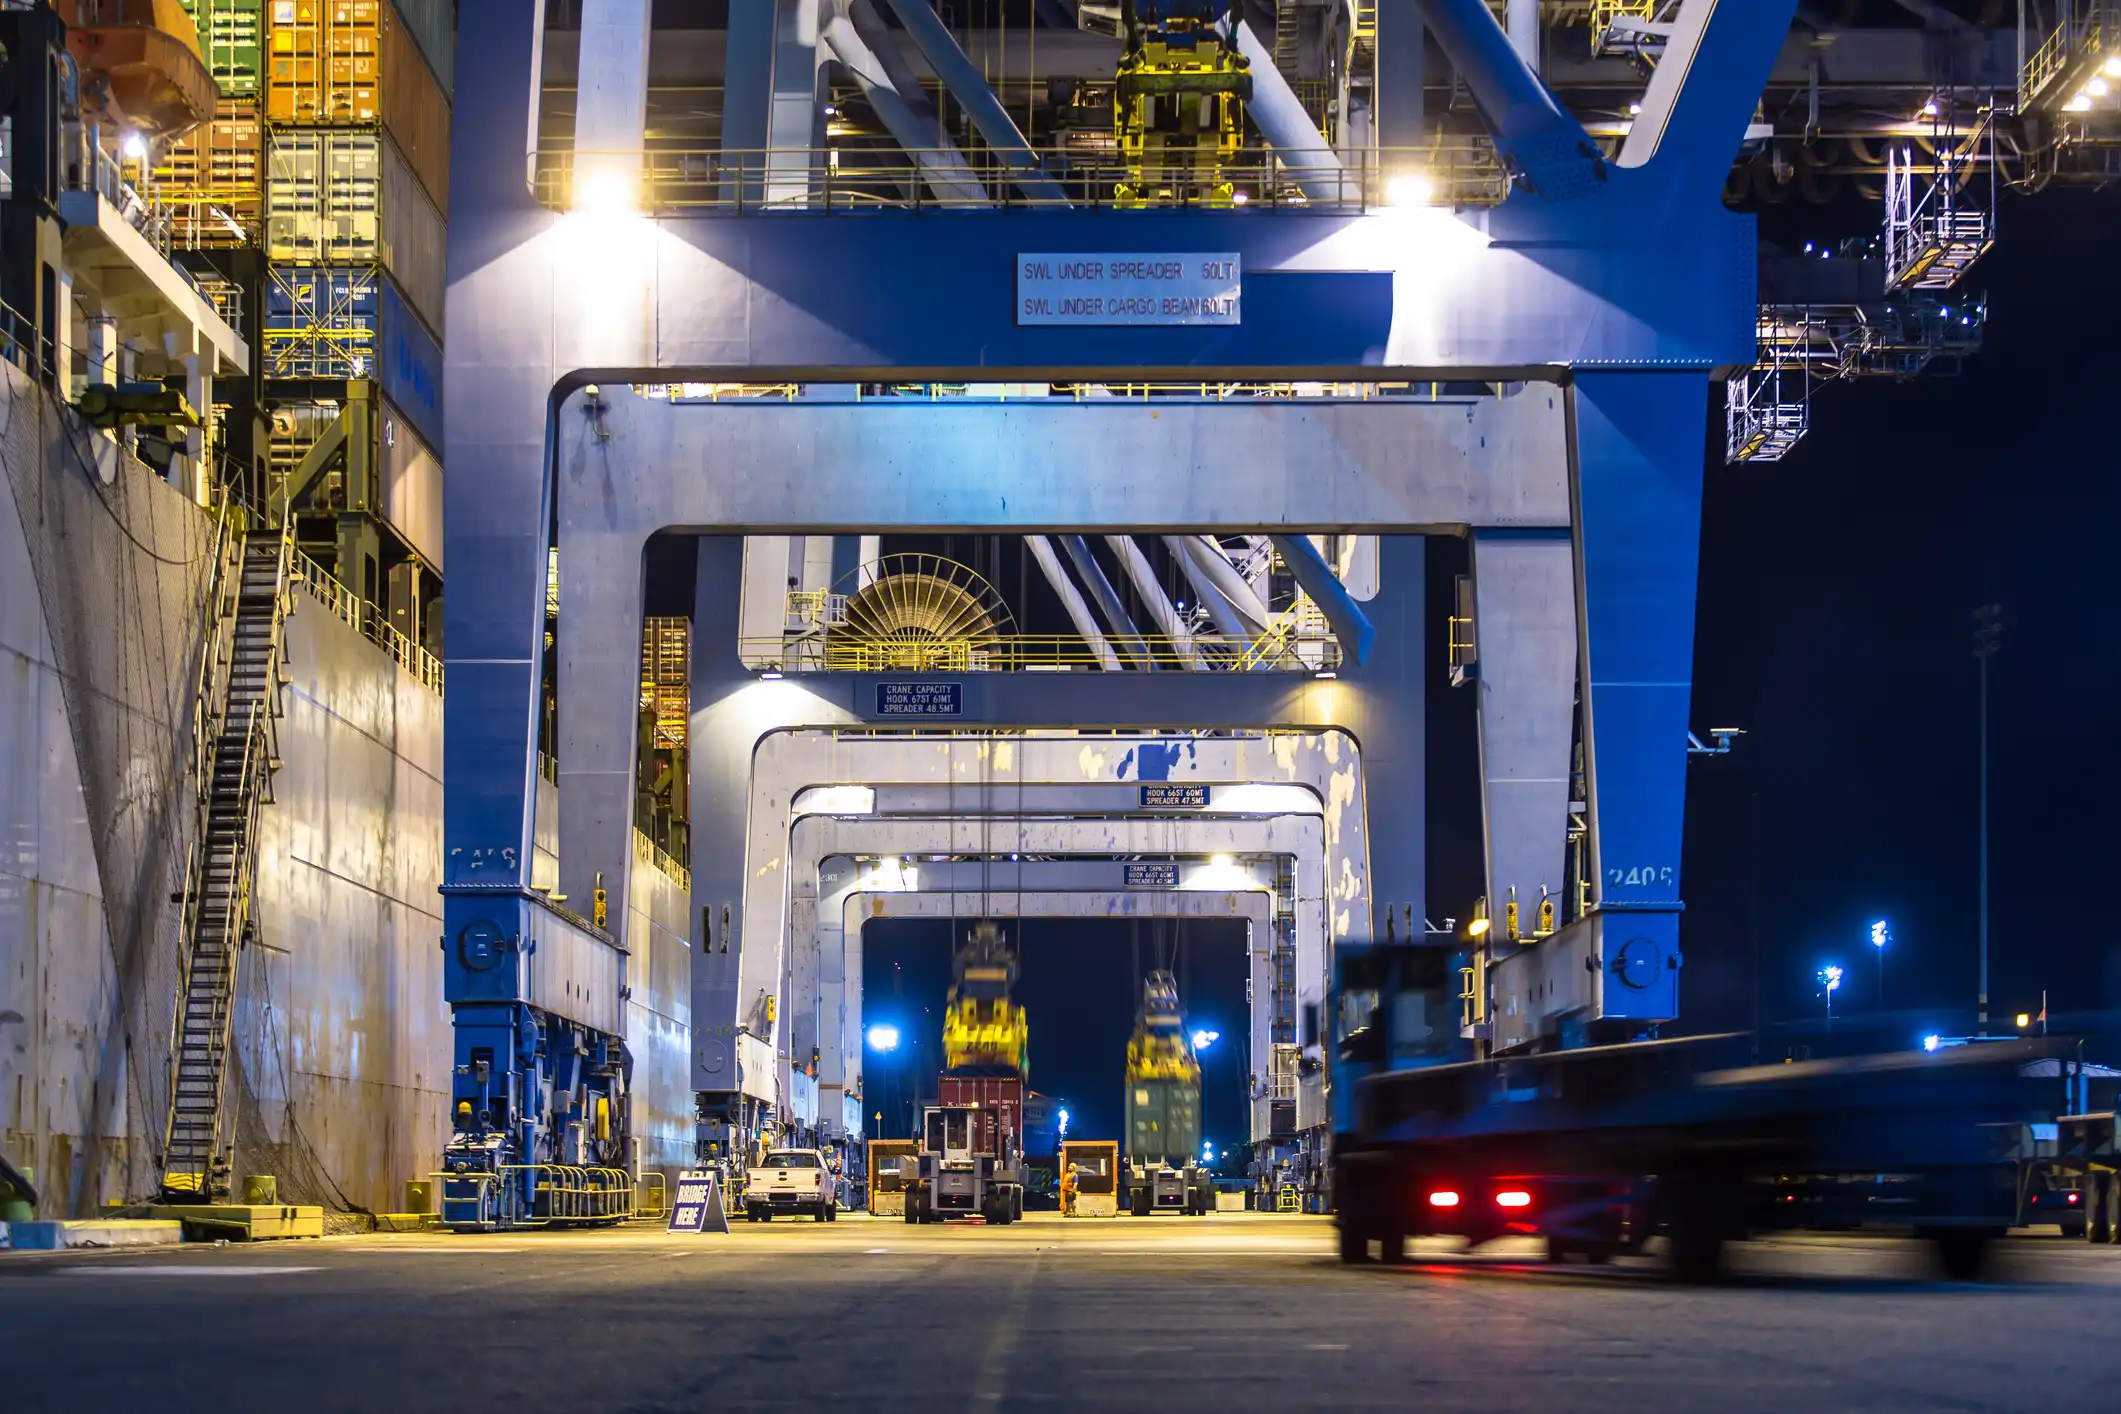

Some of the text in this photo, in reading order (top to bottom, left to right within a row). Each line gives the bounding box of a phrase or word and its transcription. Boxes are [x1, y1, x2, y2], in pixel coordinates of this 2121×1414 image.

[1024, 263, 1052, 279] SWL
[1058, 263, 1103, 279] UNDER
[1110, 263, 1184, 279] SPREADER
[1024, 298, 1234, 316] SWL UNDER CARGO BEAM 60LT
[886, 686, 951, 694] CRANE CAPACITY
[886, 695, 951, 703] HOOK 67ST 61MT
[884, 704, 954, 713] SPREADER 48.5MT
[1147, 789, 1204, 797] HOOK 66ST 60MT
[1146, 797, 1204, 805] SPREADER 47.5MT
[677, 1185, 708, 1203] BRIDGE
[675, 1207, 699, 1225] HERE
